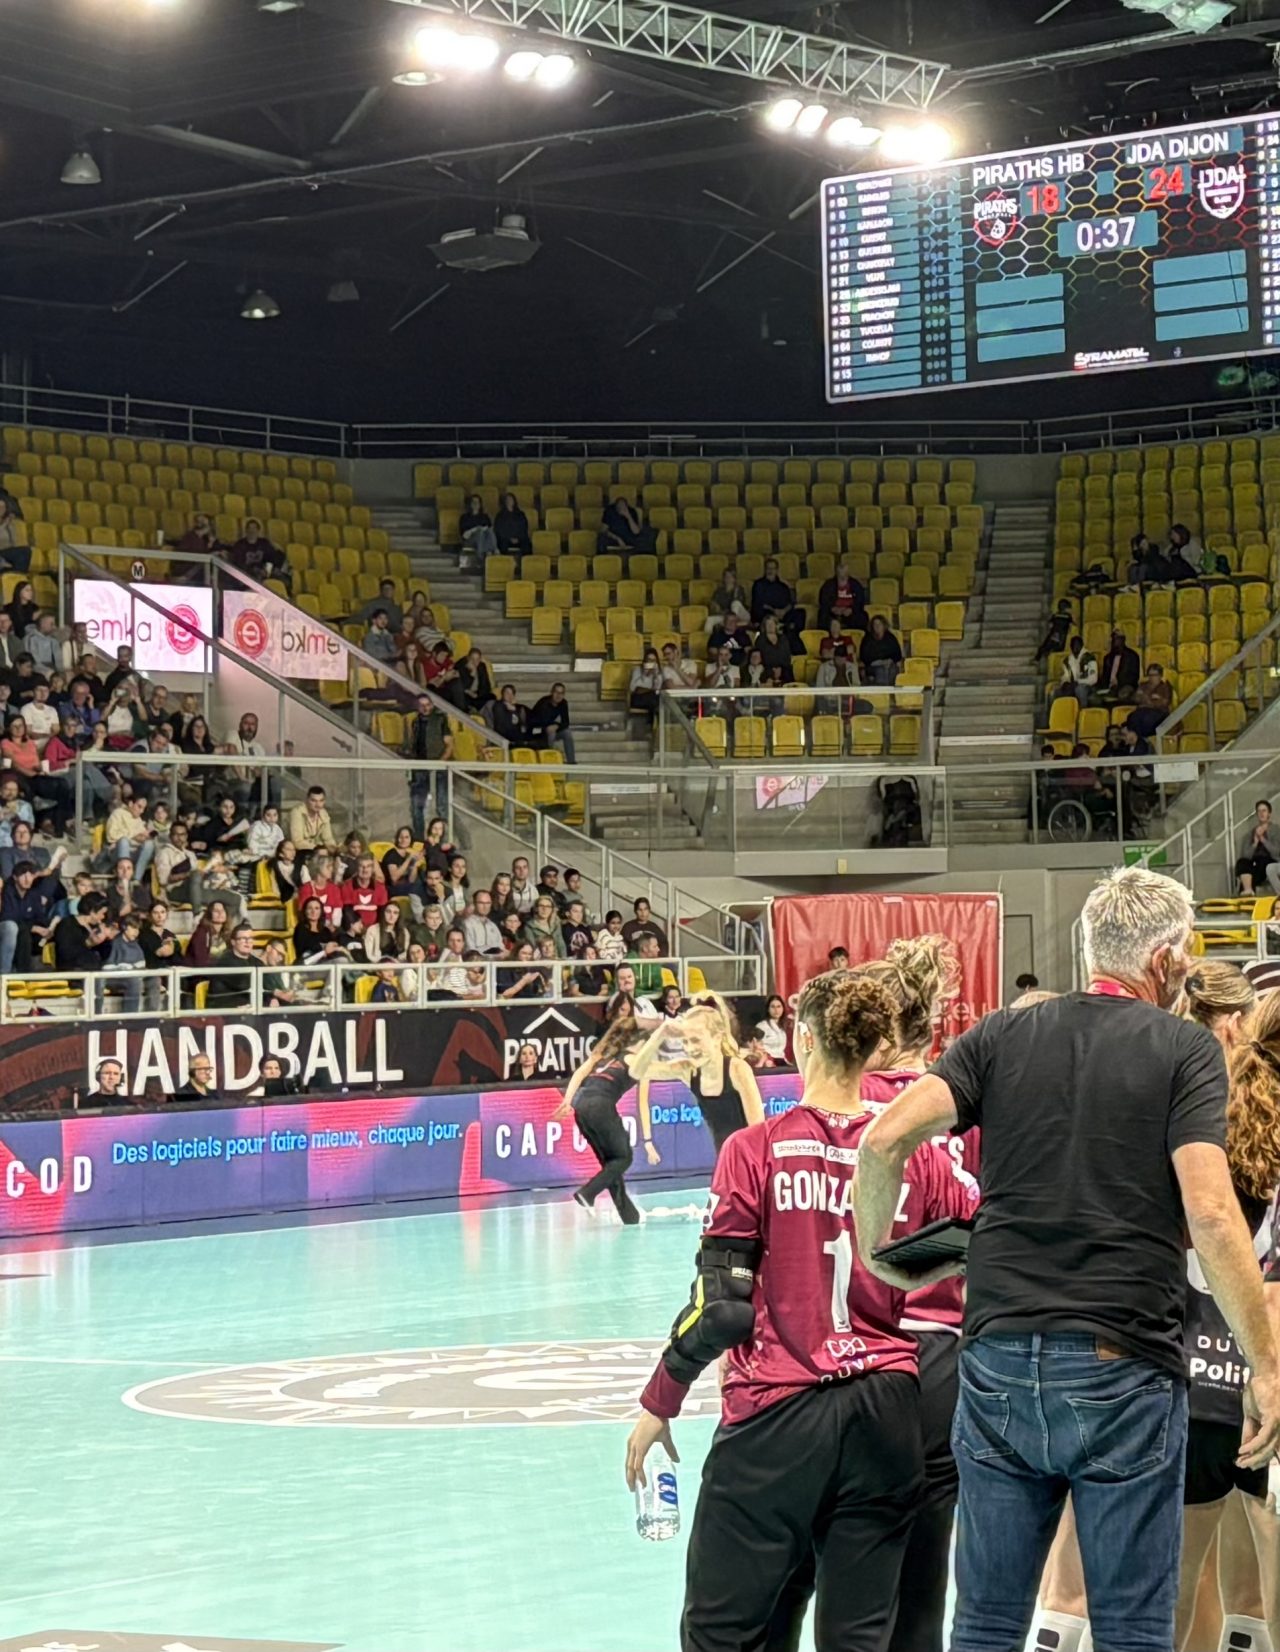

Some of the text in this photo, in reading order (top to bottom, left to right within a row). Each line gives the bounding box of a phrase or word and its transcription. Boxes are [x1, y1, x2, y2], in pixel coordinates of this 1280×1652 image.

[1127, 131, 1229, 166] JDA DIJON
[973, 153, 1085, 187] PIRATHS HB
[1149, 166, 1184, 199] 24
[1027, 184, 1059, 214] 18
[1076, 216, 1136, 250] 0:37
[133, 564, 143, 576] M
[86, 612, 152, 642] emka
[88, 1018, 404, 1097] HANDBALL
[651, 1104, 679, 1125] Des
[112, 1120, 463, 1167] Des logiciels pour faire mieux, chaque jour.
[822, 1228, 853, 1334] 1
